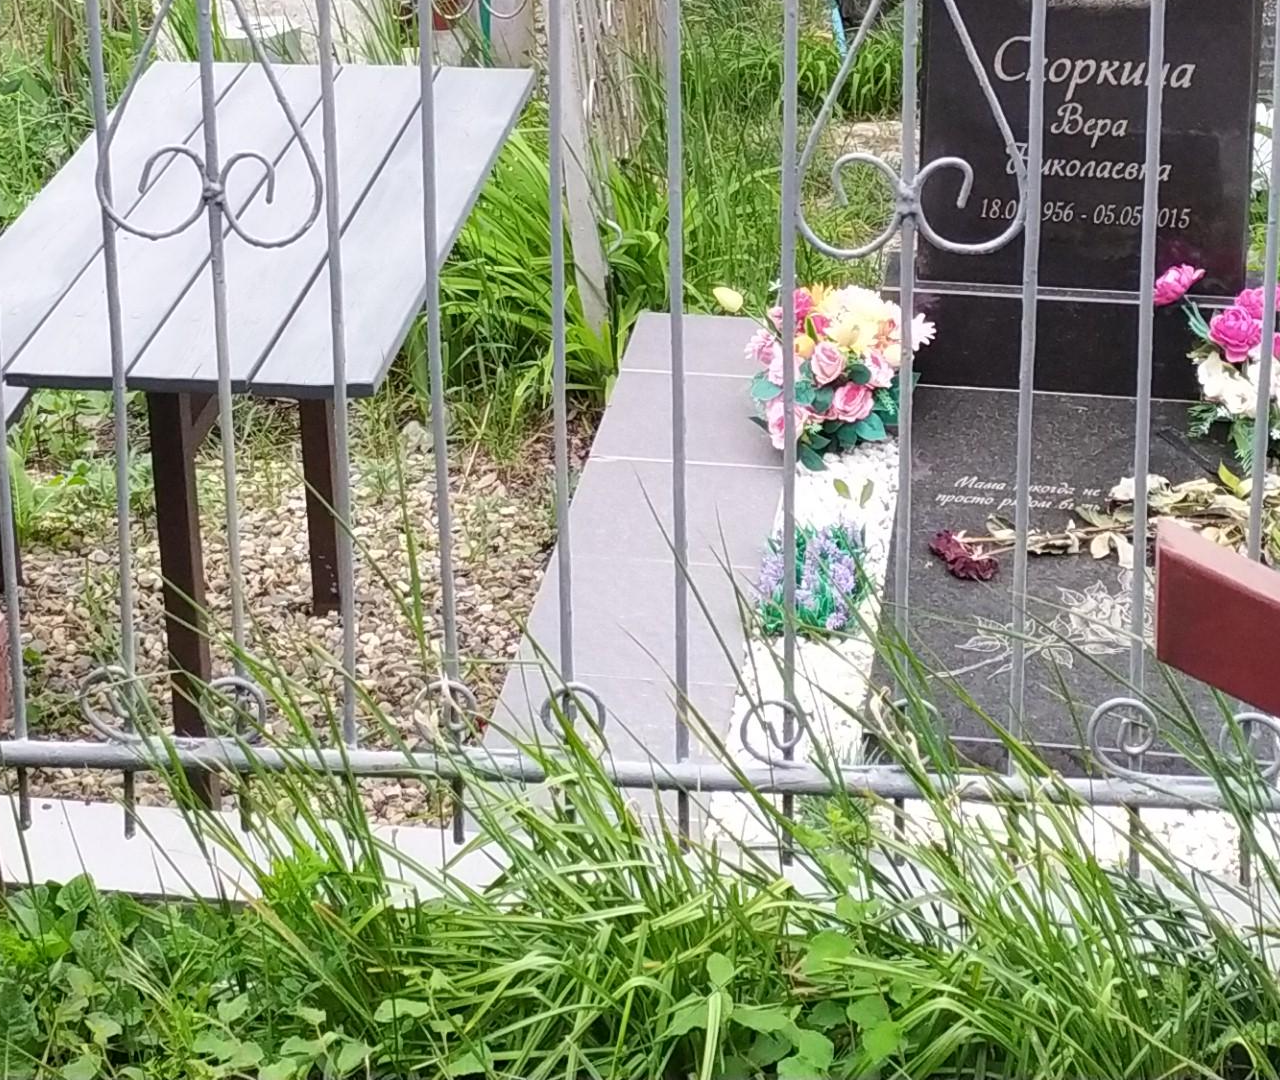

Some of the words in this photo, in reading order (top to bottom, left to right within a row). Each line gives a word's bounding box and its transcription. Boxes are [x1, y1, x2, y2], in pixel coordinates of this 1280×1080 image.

[1051, 103, 1128, 149] Вера
[980, 198, 1075, 222] 18.0956
[1093, 204, 1192, 229] 05.05015
[954, 475, 1007, 490] Мама
[1012, 482, 1076, 496] когда
[1082, 487, 1101, 497] не
[935, 493, 995, 507] просто
[997, 495, 1053, 511] ром
